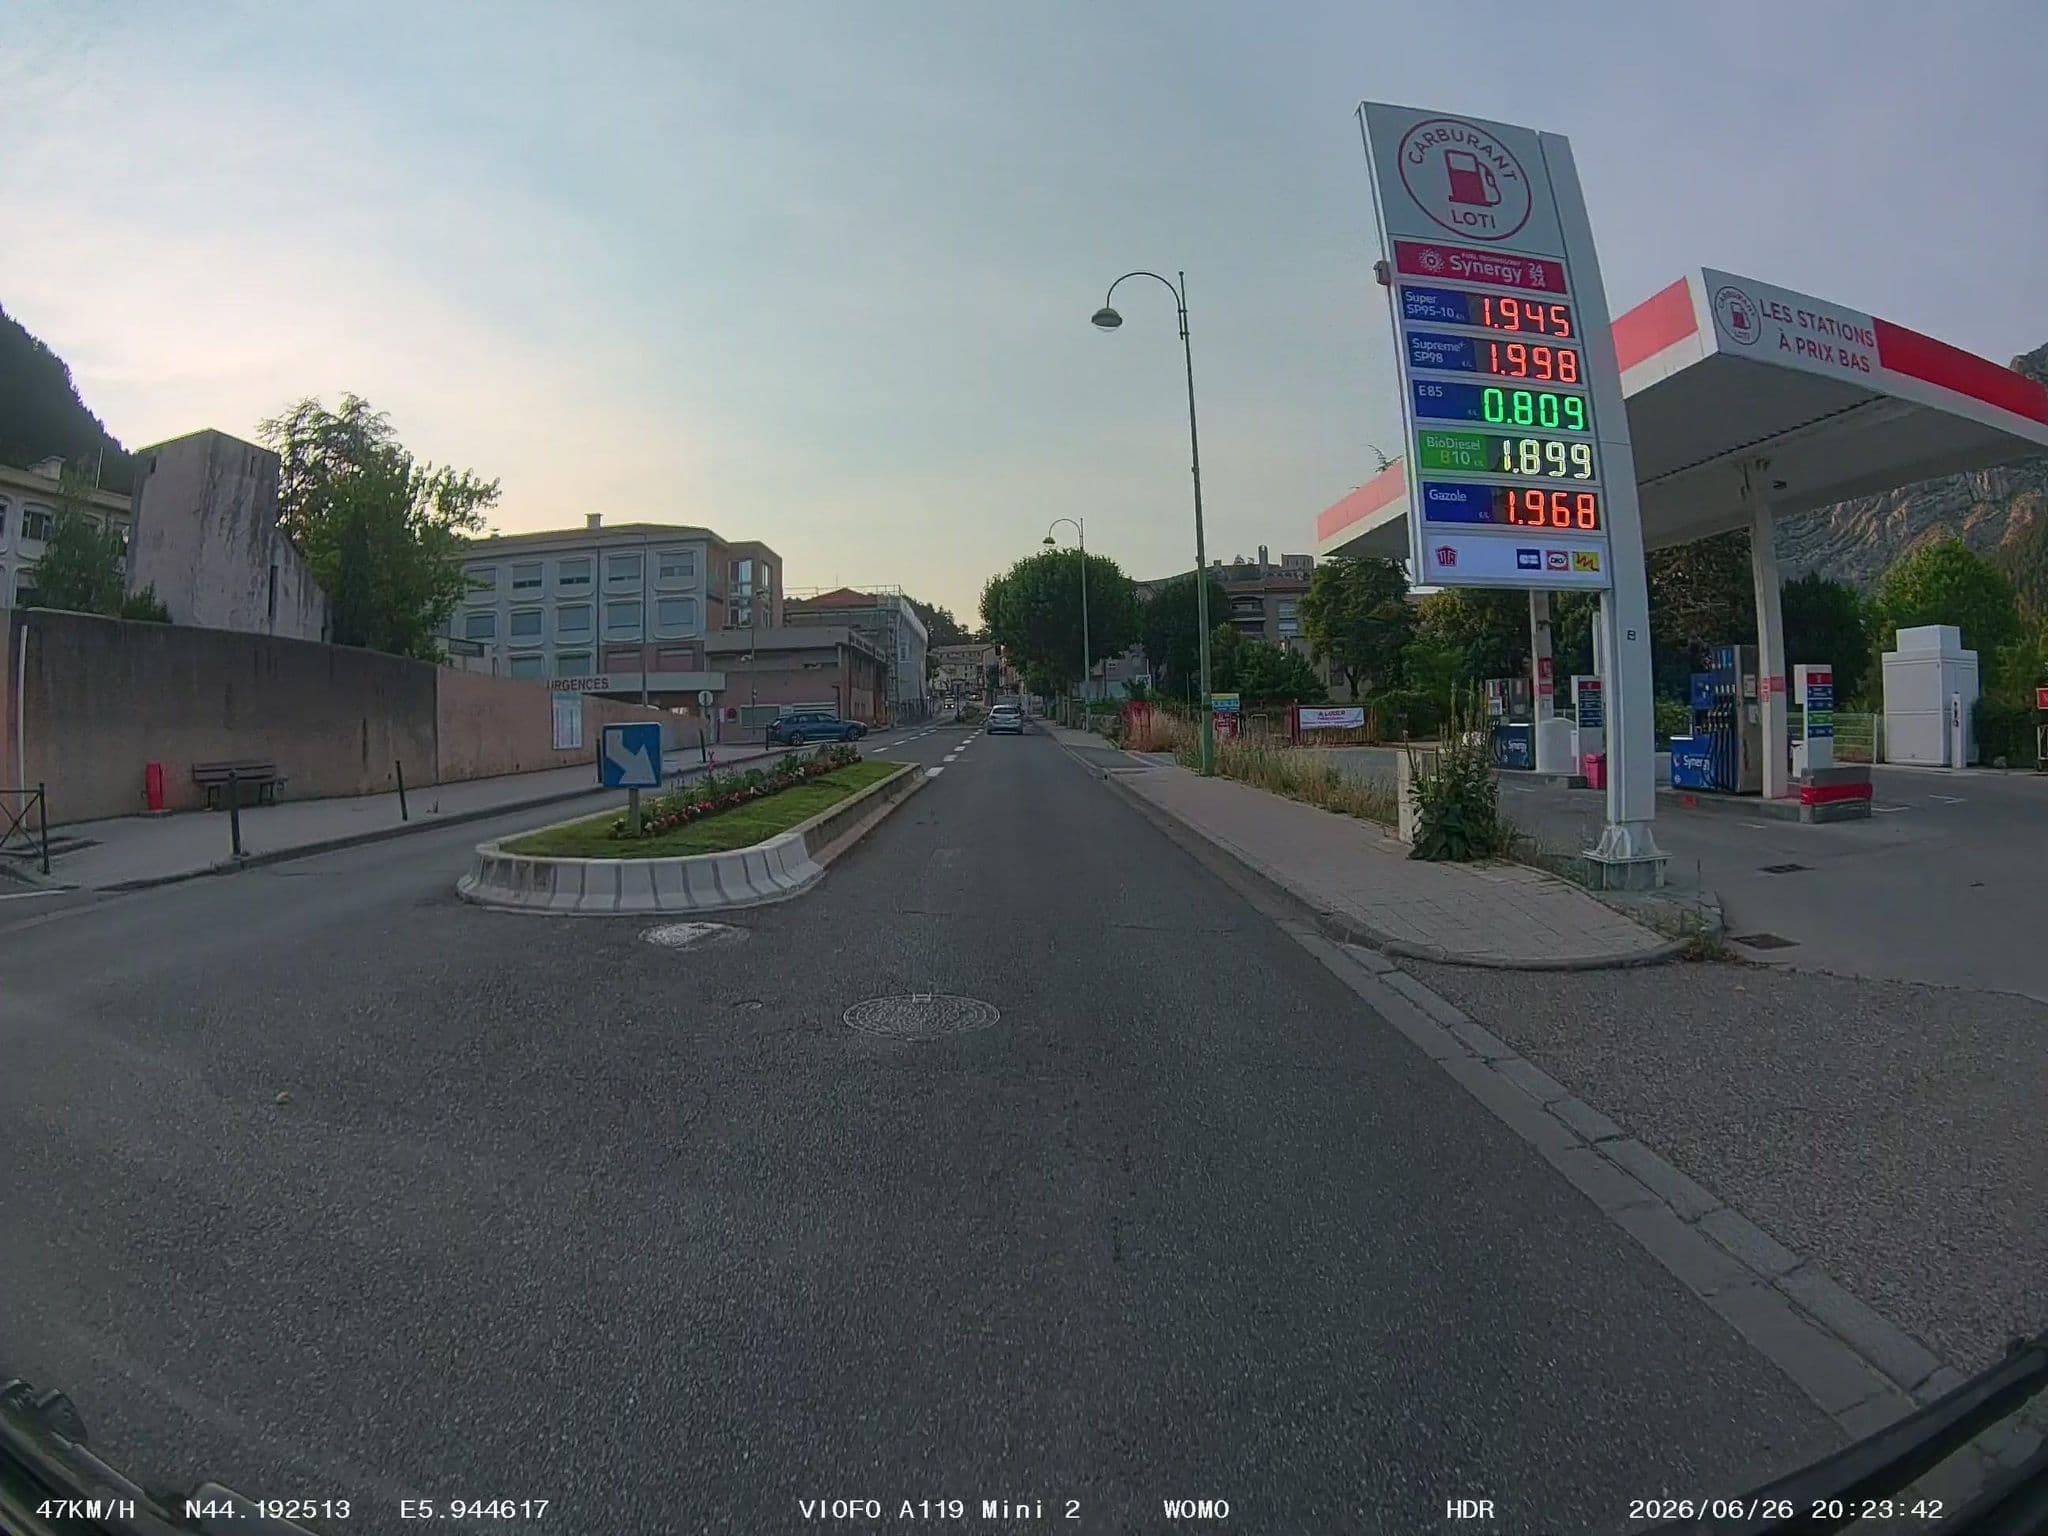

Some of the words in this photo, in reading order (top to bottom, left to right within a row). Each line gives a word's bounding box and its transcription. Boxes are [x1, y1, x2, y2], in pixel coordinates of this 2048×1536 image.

[1408, 127, 1518, 181] CARBURANT
[1451, 208, 1496, 229] LOTI
[1450, 254, 1523, 284] Synergy
[1404, 291, 1437, 305] Super
[1407, 303, 1455, 318] SP95-10
[1483, 298, 1569, 337] 1.945
[1759, 299, 1794, 324] LES
[1796, 310, 1875, 348] STATIONS
[1414, 351, 1444, 363] SP98
[1490, 342, 1577, 383] 1.998
[1778, 327, 1791, 351] À
[1795, 337, 1834, 363] PRIX
[1839, 349, 1870, 373] BAS
[1418, 385, 1443, 397] E85
[1483, 388, 1584, 431] 0.809
[1426, 436, 1481, 451] BioDiesel
[1503, 438, 1592, 479] 1.899
[1429, 489, 1467, 502] Gazole
[1507, 490, 1595, 529] 1.968
[546, 678, 609, 691] URGENCES
